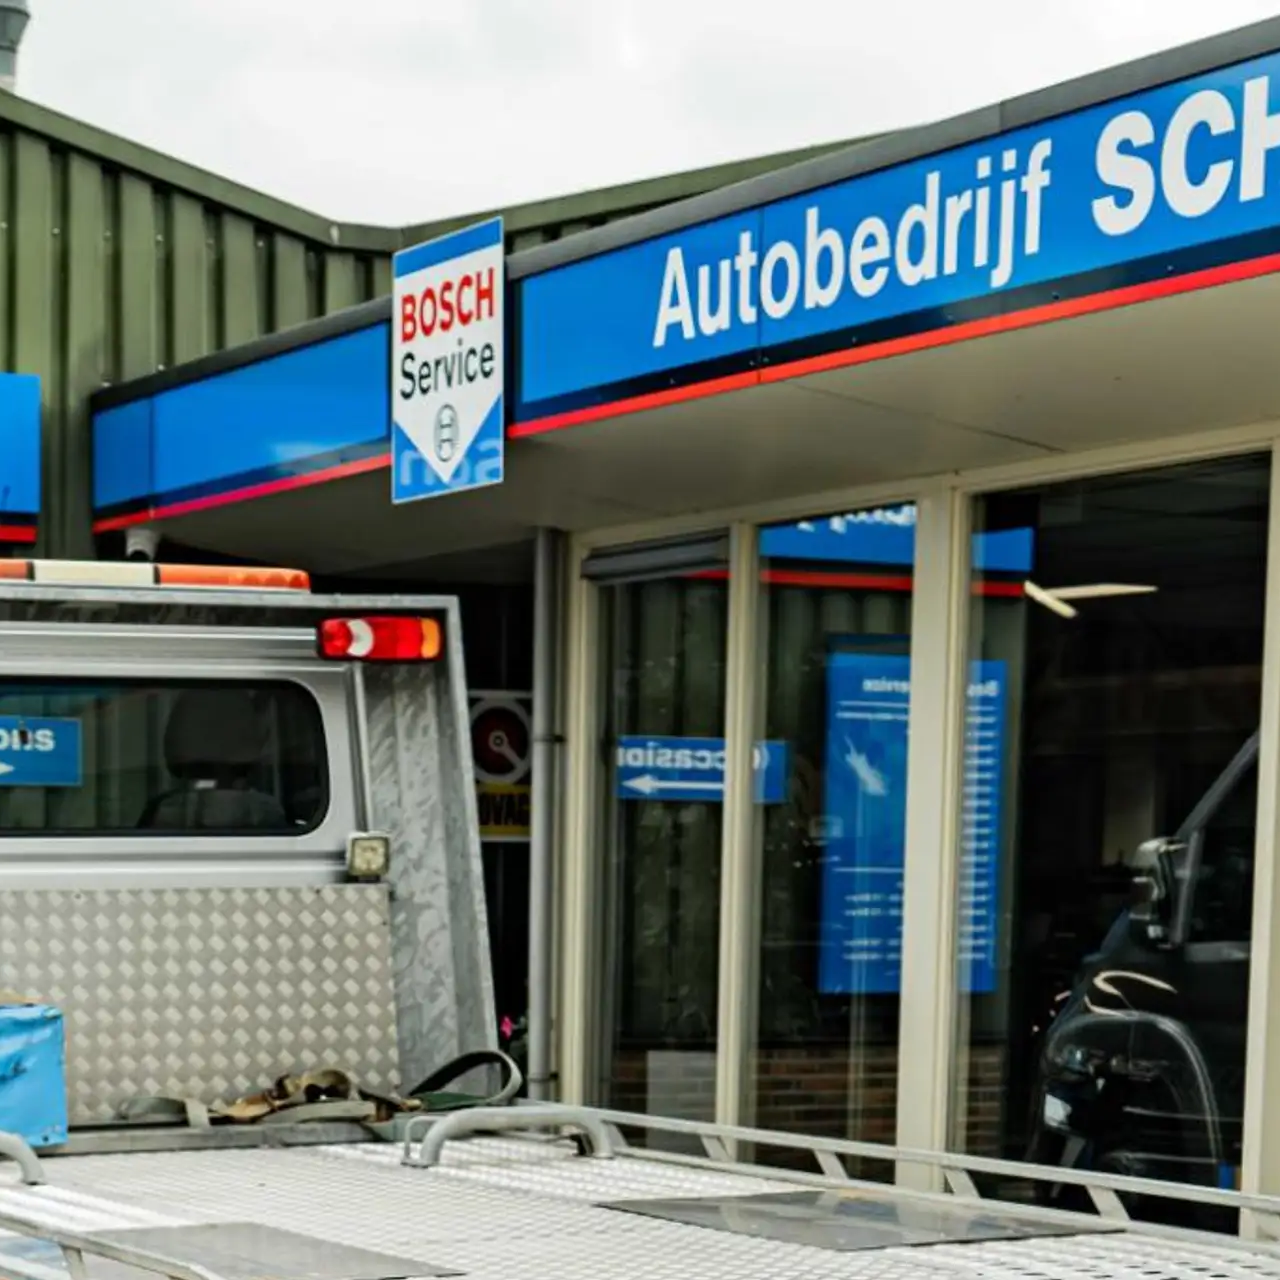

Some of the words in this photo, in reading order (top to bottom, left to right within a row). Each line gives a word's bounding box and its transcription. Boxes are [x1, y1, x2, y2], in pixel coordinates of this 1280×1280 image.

[652, 137, 1052, 348] Autobedrijf
[400, 267, 495, 343] BOSCH
[399, 337, 495, 401] Service
